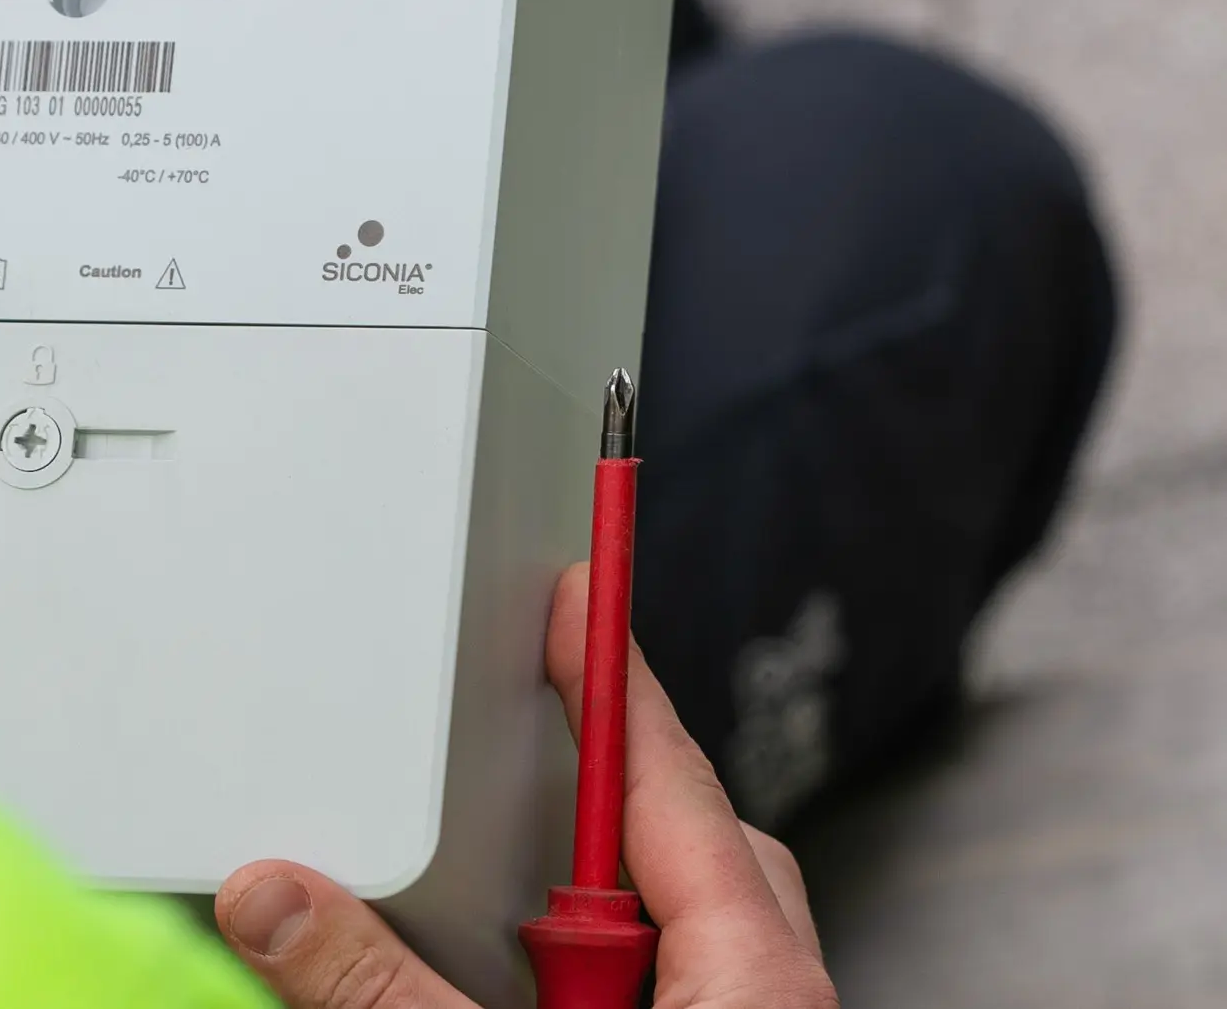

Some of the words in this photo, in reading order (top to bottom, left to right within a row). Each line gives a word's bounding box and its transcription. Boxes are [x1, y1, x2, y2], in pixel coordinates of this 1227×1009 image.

[16, 95, 41, 116] 103
[48, 95, 65, 117] 01
[73, 95, 143, 118] 00000055
[19, 131, 47, 146] 400
[48, 131, 61, 146] V
[74, 131, 110, 146] 50Hz
[121, 132, 151, 149] 0,25
[174, 132, 209, 150] (100)
[209, 133, 222, 147] A
[167, 169, 210, 184] +70°C
[78, 264, 142, 279] Caution
[321, 261, 425, 282] SICONIA
[397, 284, 425, 295] Elec
